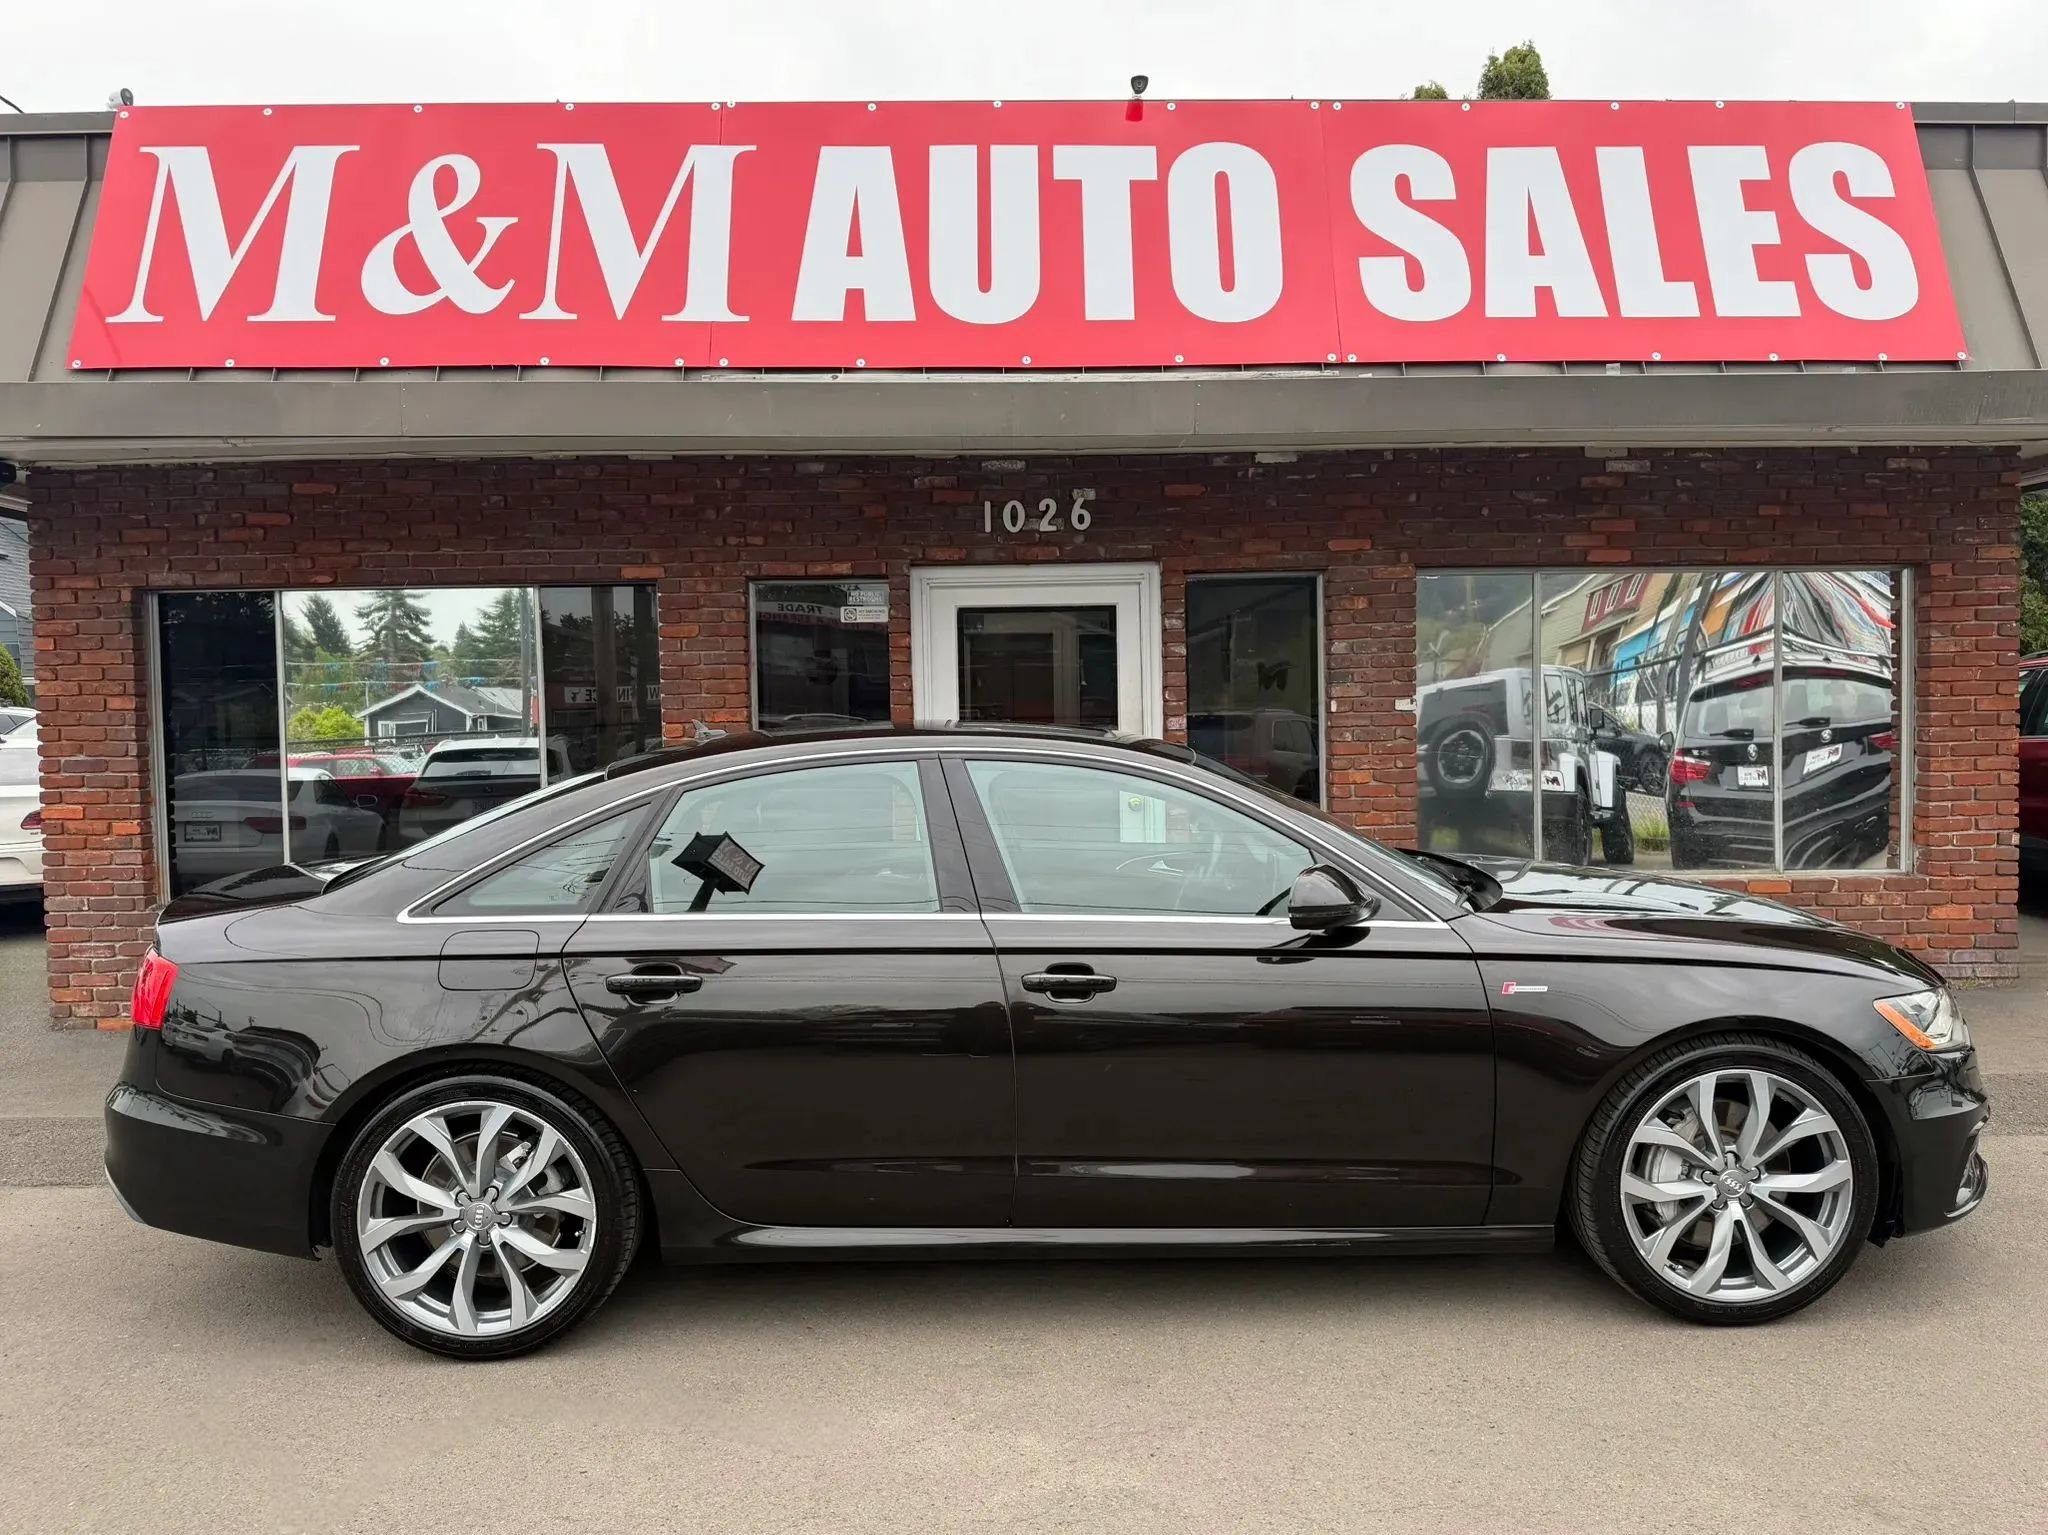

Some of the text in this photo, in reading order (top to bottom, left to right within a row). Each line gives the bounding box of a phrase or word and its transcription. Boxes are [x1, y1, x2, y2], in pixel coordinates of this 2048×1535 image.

[791, 144, 1284, 324] AUTO
[1350, 141, 1920, 322] SALES
[984, 498, 1091, 533] 1026
